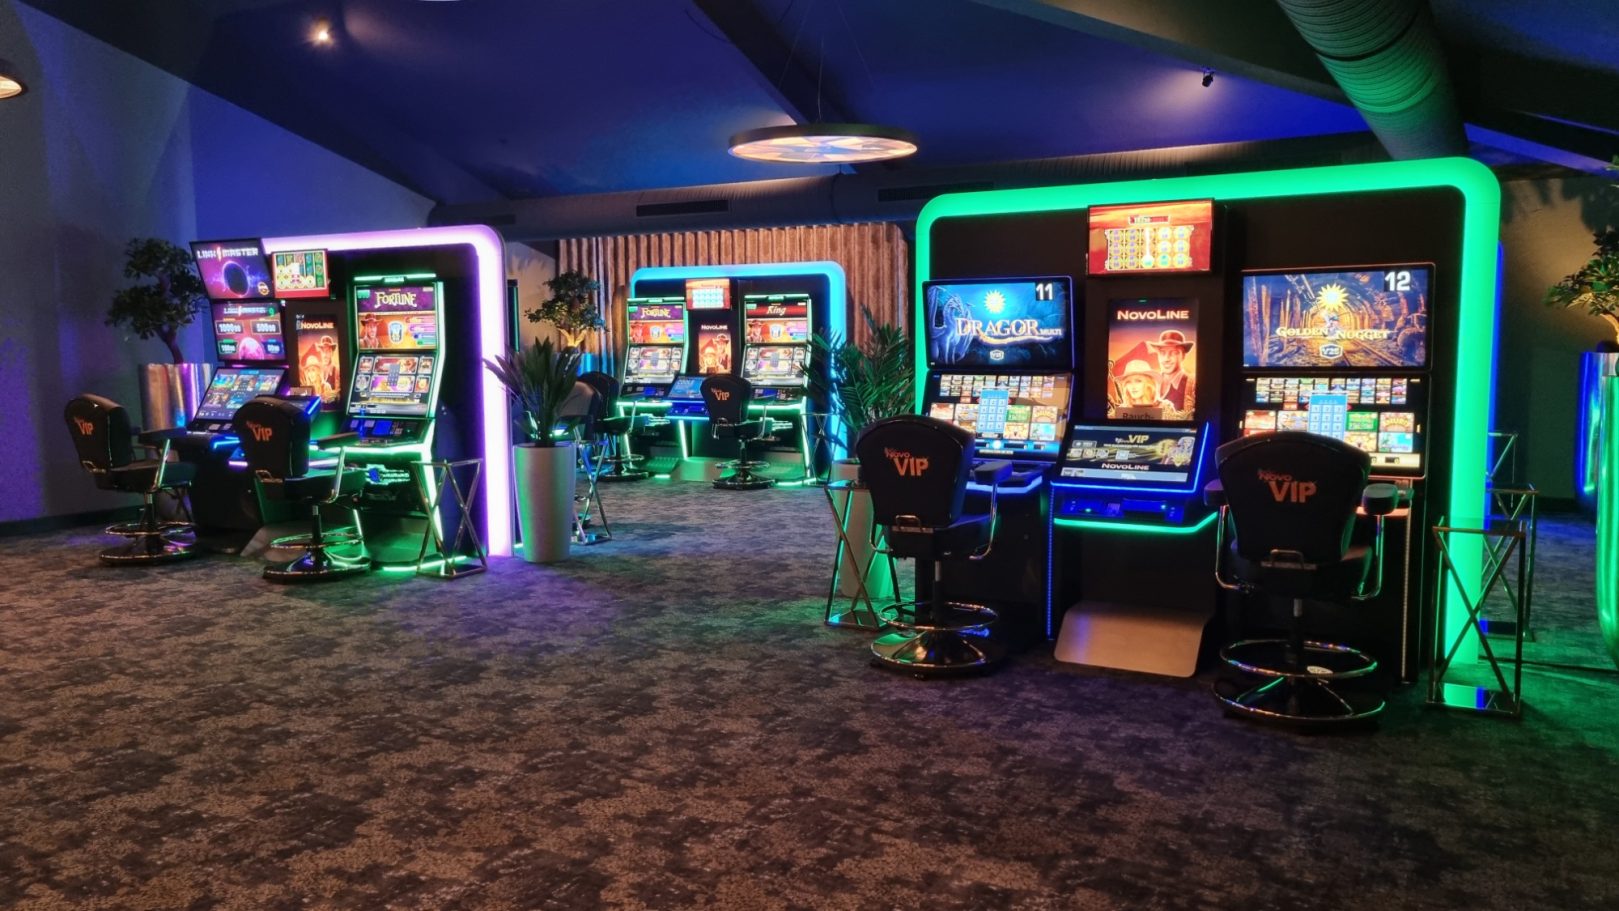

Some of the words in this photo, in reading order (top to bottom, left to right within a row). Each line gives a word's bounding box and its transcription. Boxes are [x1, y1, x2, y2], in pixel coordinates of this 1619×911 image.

[1385, 271, 1411, 291] 12
[1036, 283, 1053, 300] 11
[374, 292, 417, 309] FORTUNE
[955, 318, 1039, 337] DRAGOR
[1275, 327, 1328, 338] GOLDEN
[1335, 328, 1390, 340] NUGGET
[714, 391, 730, 401] VIP
[79, 421, 94, 435] VIP
[252, 427, 273, 441] VIP
[1128, 434, 1150, 444] VIP
[893, 457, 929, 477] VIP
[1268, 480, 1318, 503] VIP
